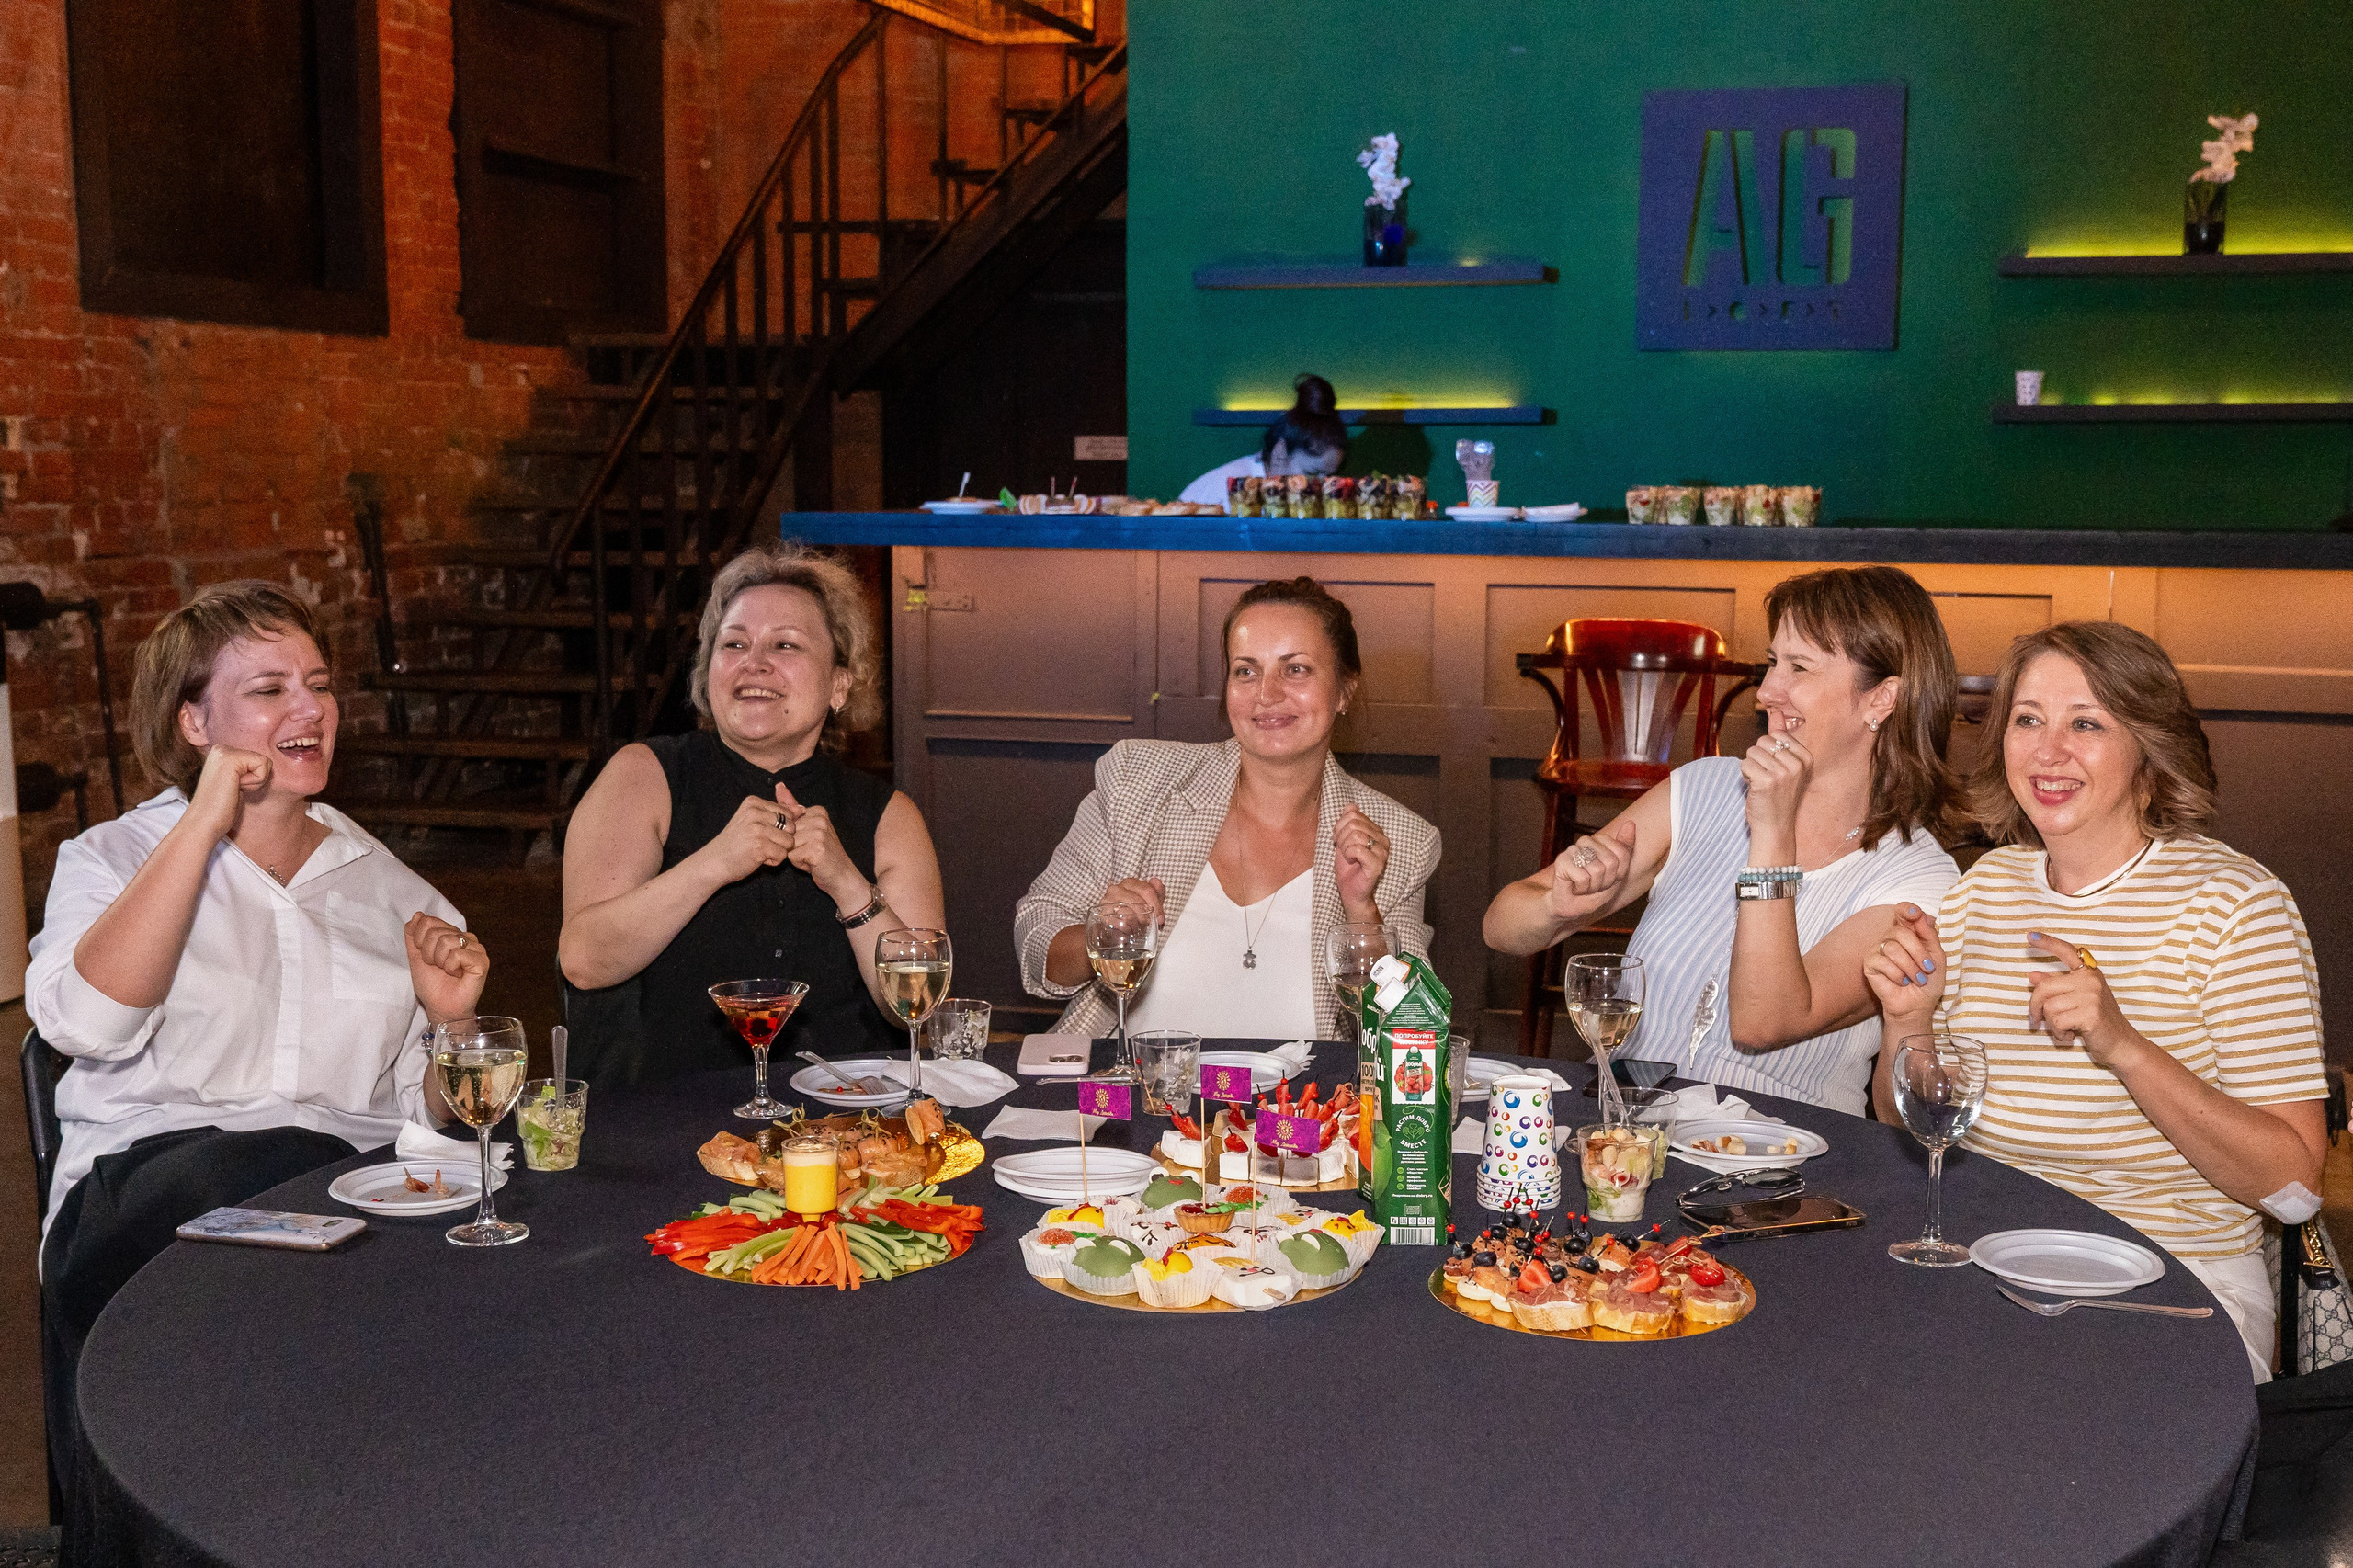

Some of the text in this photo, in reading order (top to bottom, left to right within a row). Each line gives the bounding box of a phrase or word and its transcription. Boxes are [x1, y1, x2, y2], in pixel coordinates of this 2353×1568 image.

[1683, 129, 1856, 286] AG
[1362, 1064, 1375, 1077] 100
[1396, 1115, 1431, 1132] РАСТИМ ДОБРО
[1400, 1139, 1427, 1148] ВМЕСТЕ
